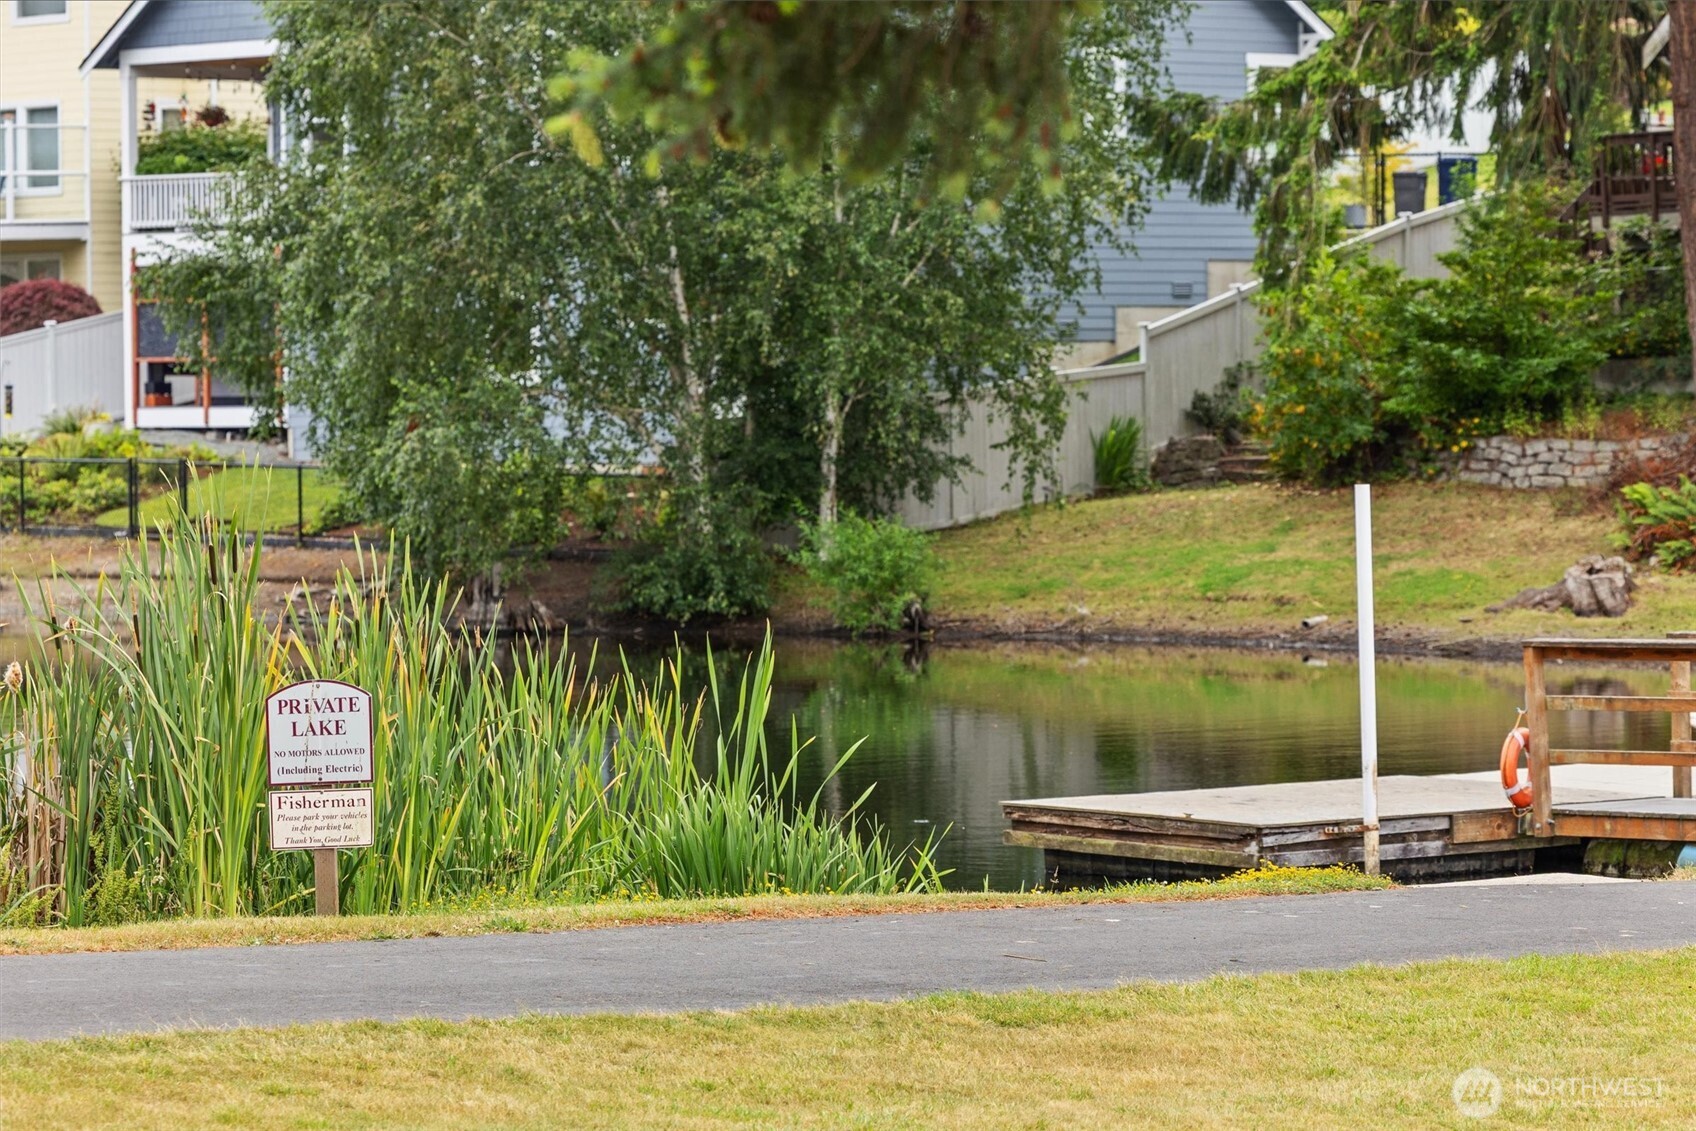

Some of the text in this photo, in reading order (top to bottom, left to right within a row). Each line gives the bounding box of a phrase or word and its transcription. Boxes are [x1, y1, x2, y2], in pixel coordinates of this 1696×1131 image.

[291, 719, 347, 737] LAKE
[324, 748, 366, 756] ALLOWED
[277, 764, 363, 776] (Including Electric)
[277, 796, 366, 810] Fisherman
[277, 814, 301, 822] Please
[302, 813, 320, 822] park
[313, 824, 341, 832] parking
[285, 837, 308, 845] Thank
[343, 835, 361, 843] Luck
